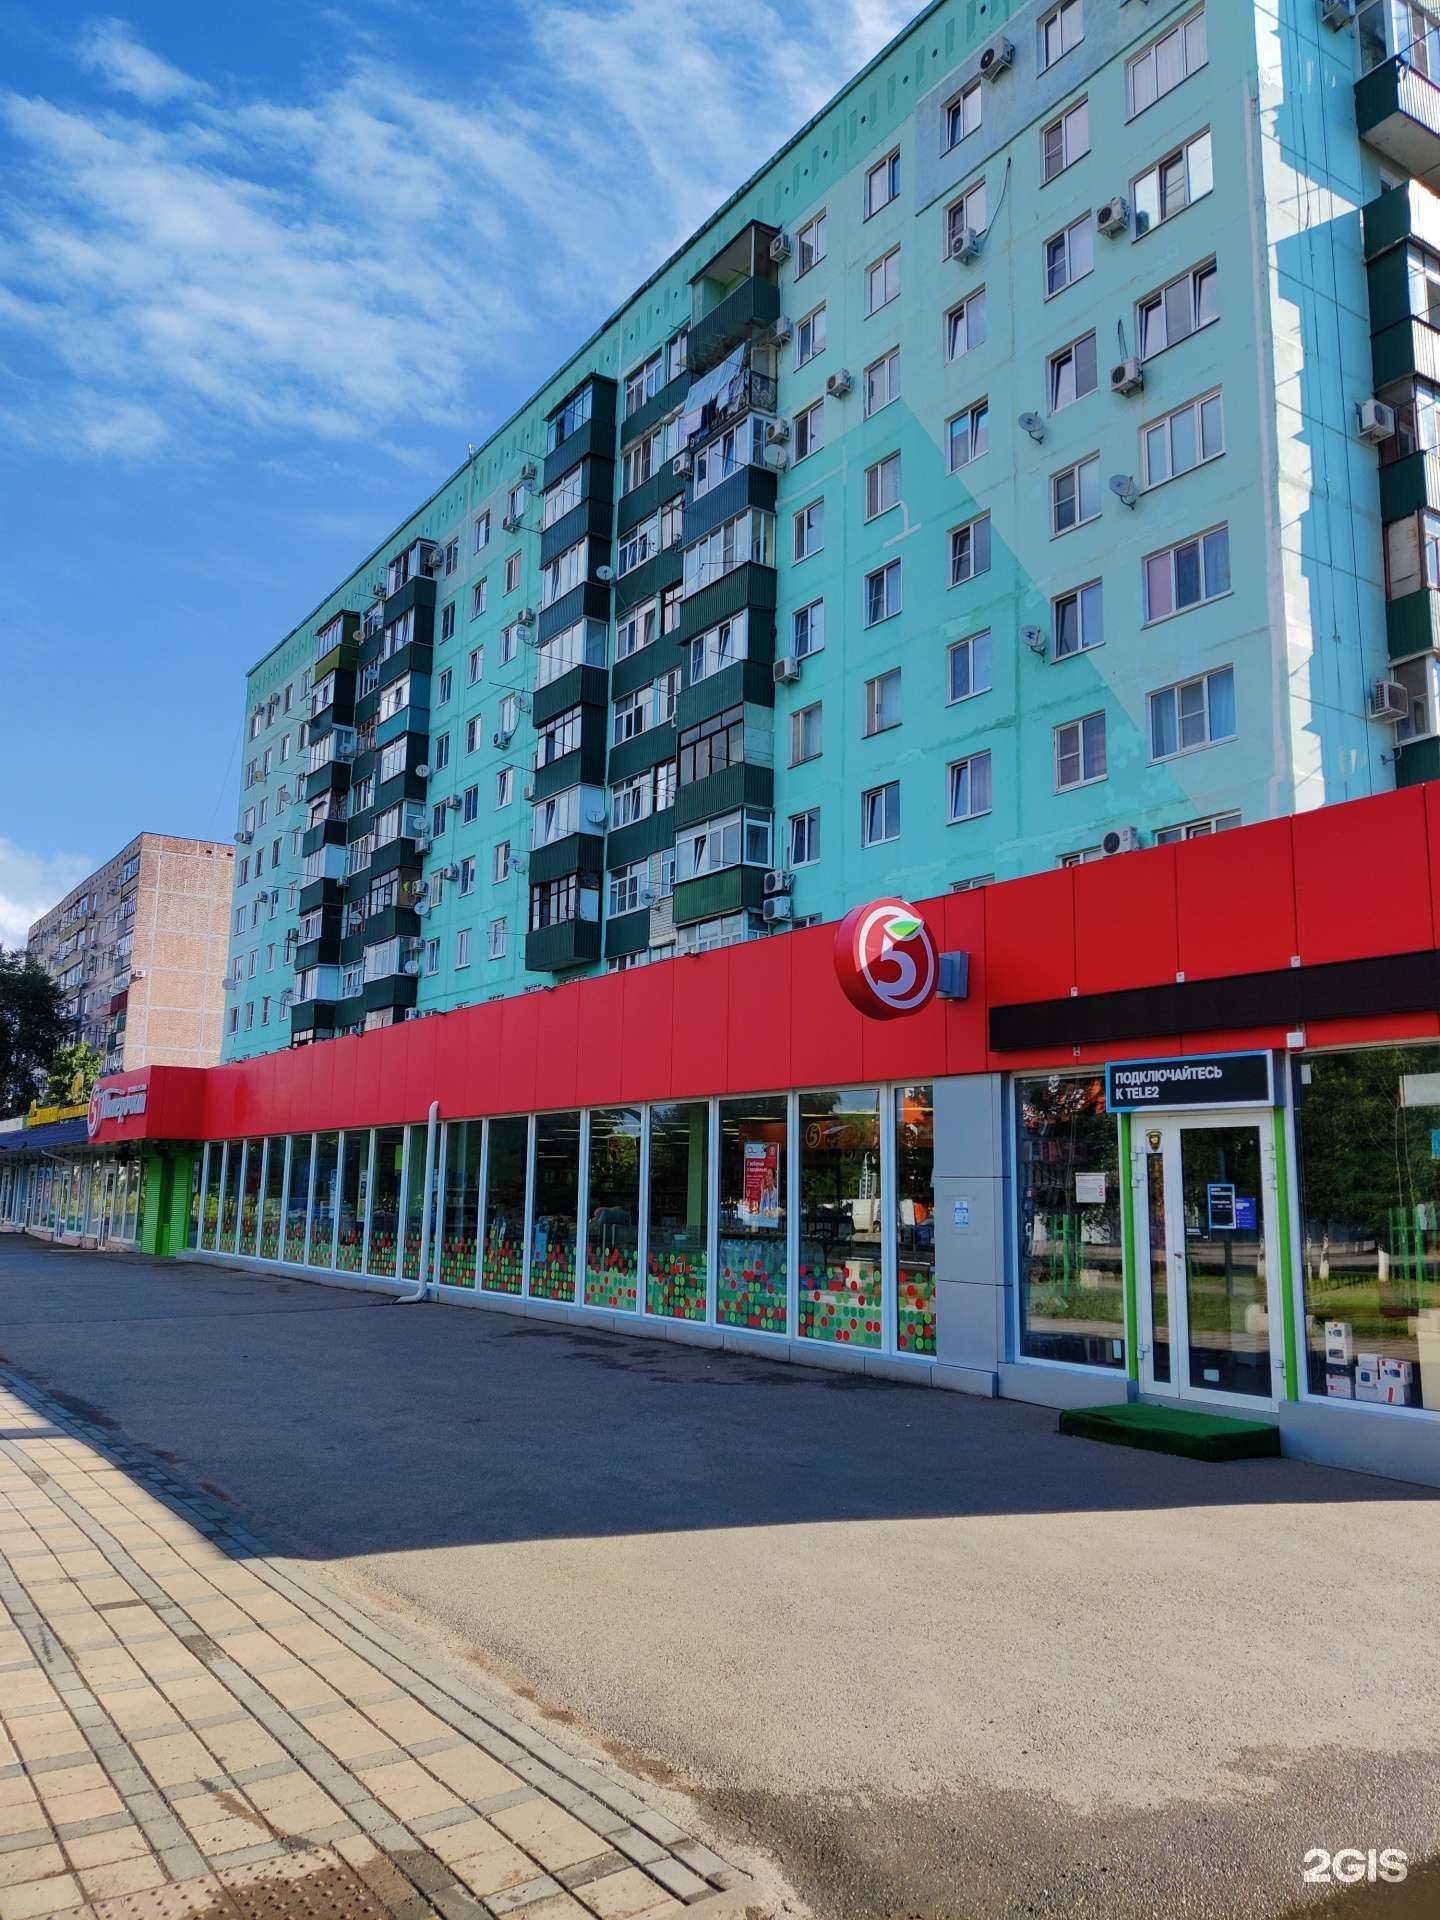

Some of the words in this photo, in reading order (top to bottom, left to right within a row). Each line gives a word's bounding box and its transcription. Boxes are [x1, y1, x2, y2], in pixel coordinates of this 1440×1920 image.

[1115, 1066, 1223, 1086] ПОДКЛЮЧАЙТЕСЬ
[1116, 1088, 1123, 1100] К
[1126, 1086, 1160, 1099] TELE2
